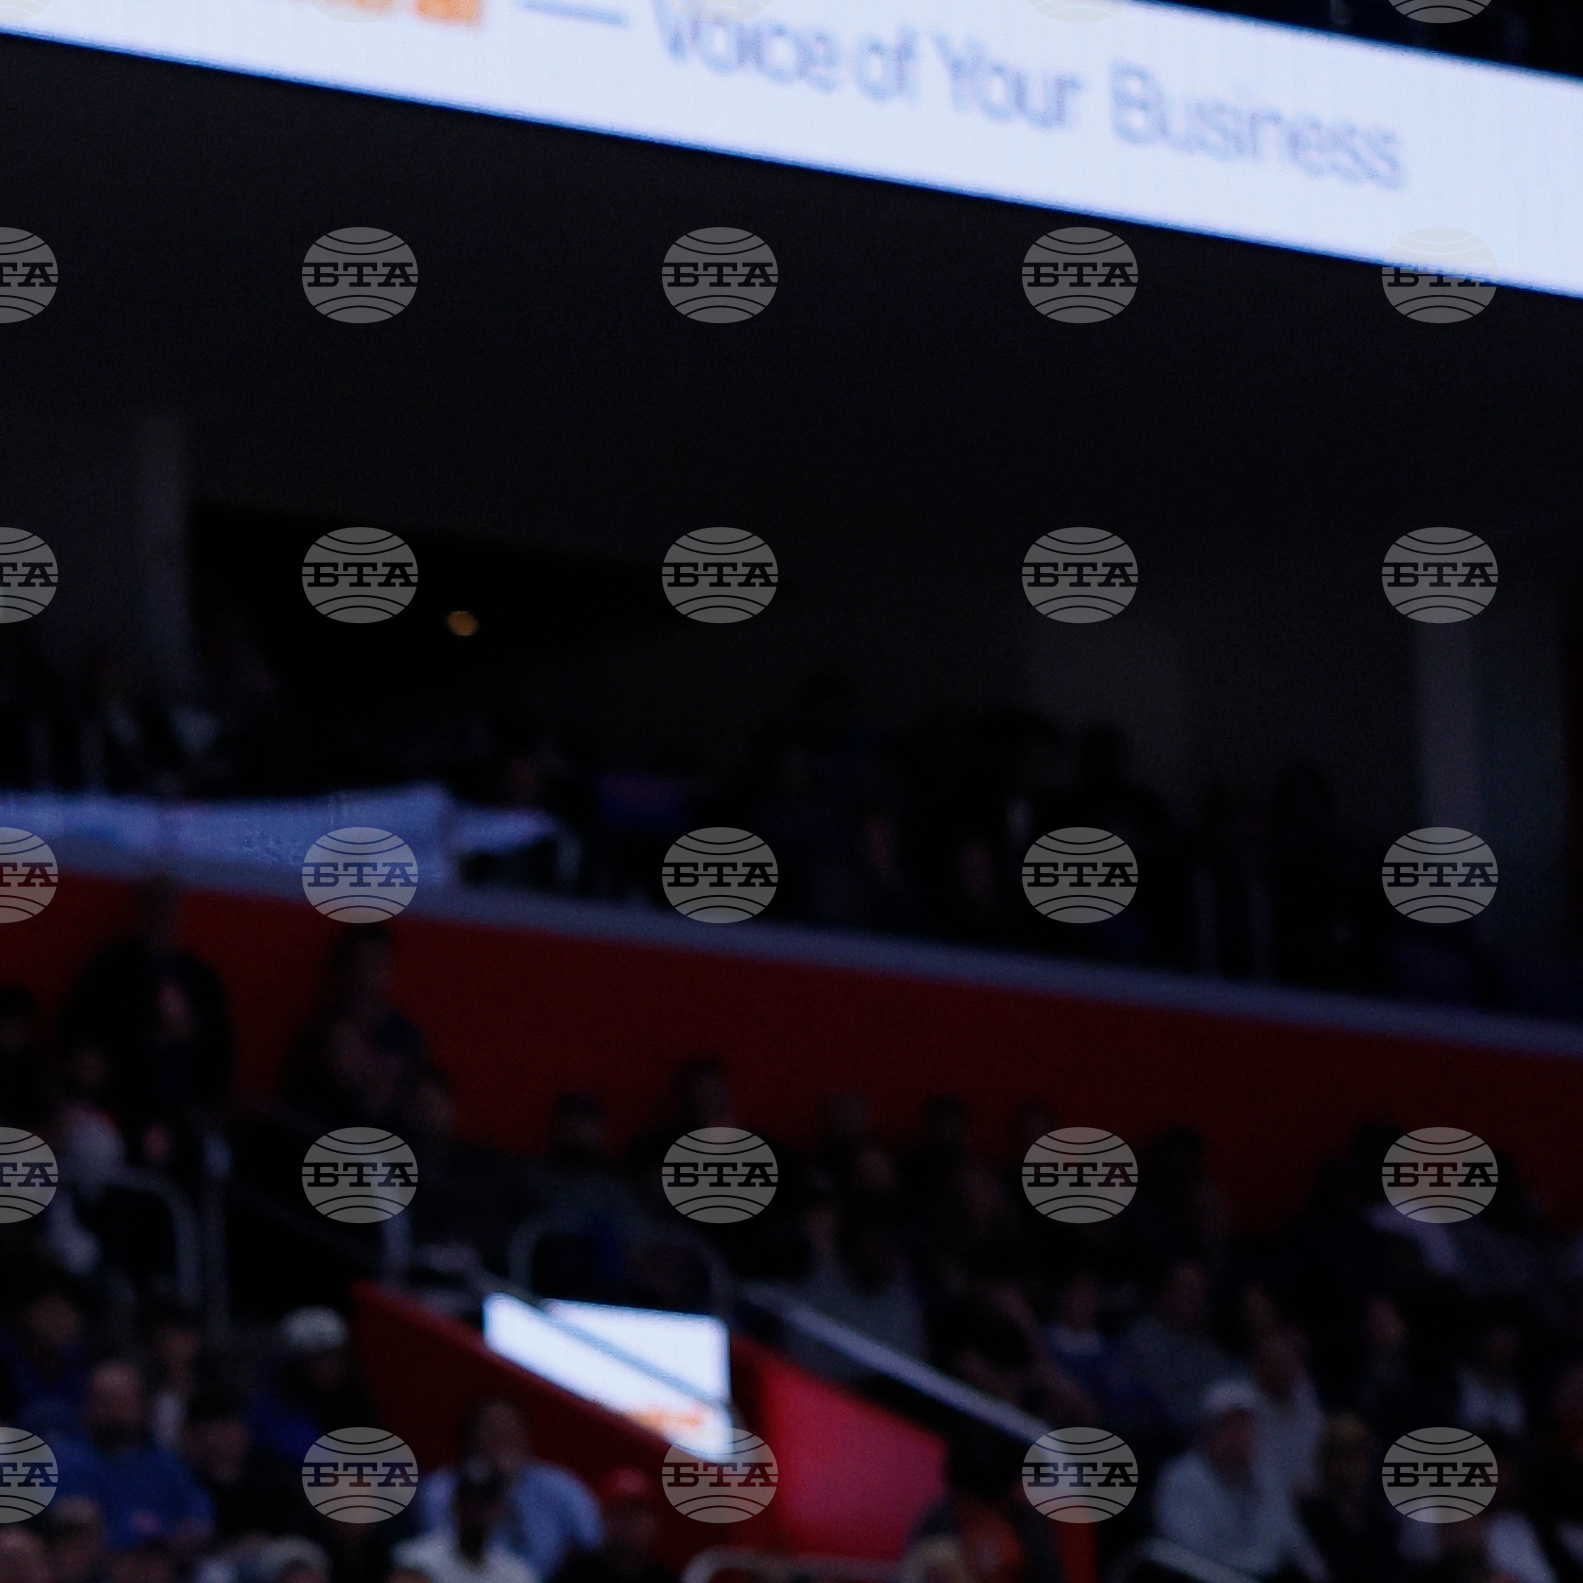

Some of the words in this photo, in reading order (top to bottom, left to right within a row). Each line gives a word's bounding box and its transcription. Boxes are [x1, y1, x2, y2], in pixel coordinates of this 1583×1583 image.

[850, 18, 918, 103] of
[926, 32, 1086, 132] Your
[1108, 60, 1406, 191] Business
